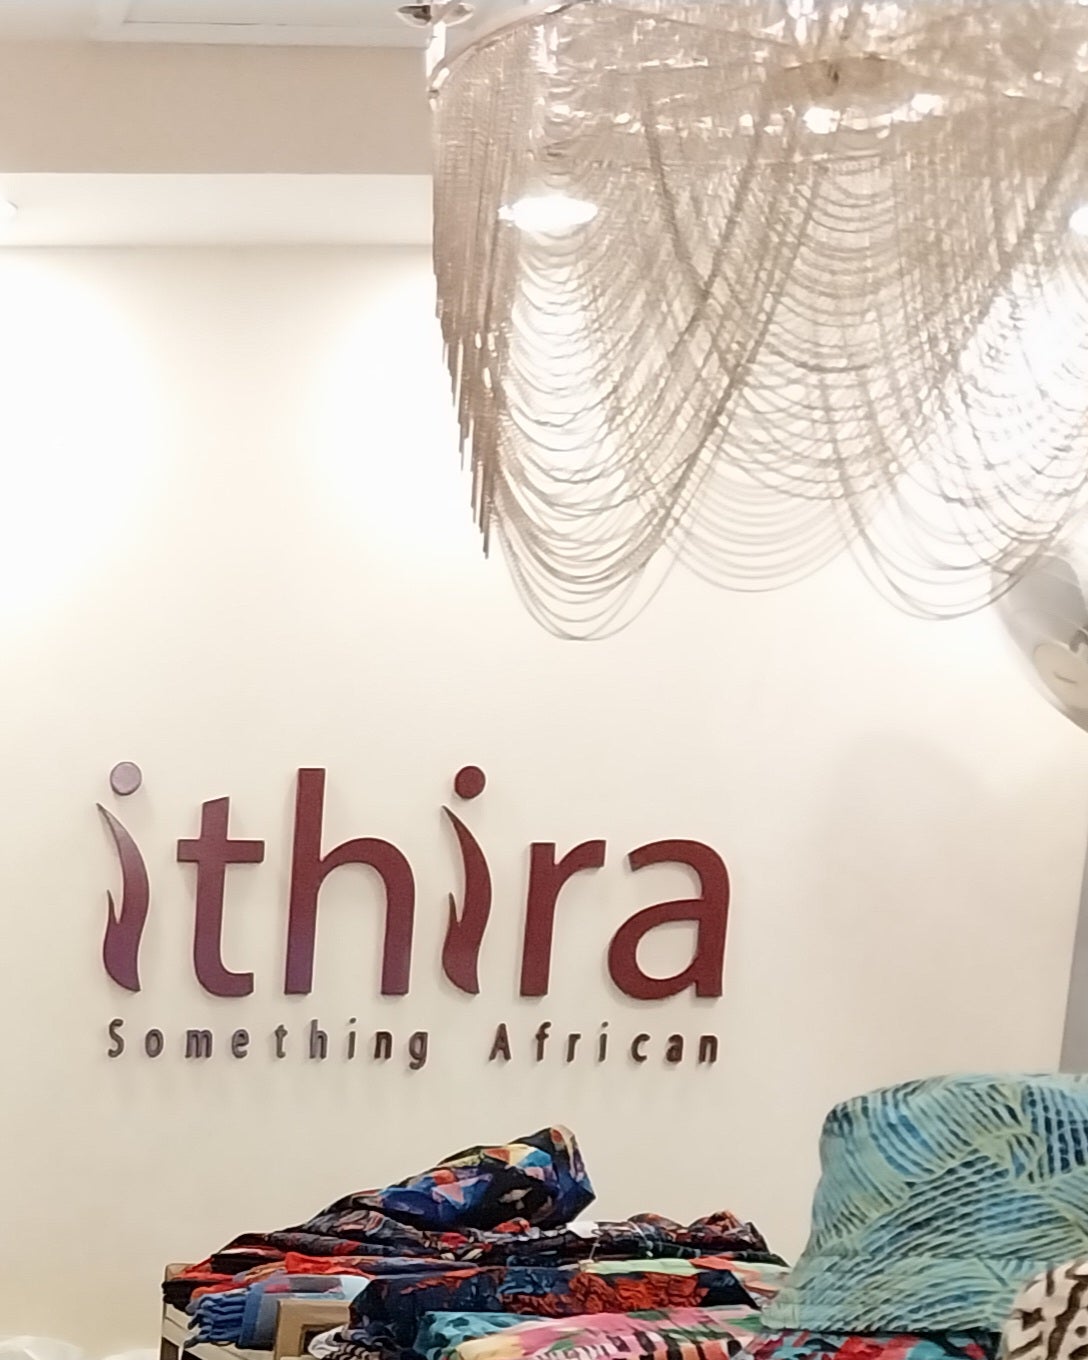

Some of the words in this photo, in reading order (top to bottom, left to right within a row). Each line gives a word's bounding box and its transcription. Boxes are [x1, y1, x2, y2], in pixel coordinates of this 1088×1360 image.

[96, 761, 731, 1000] ithira
[107, 1017, 429, 1070] Something
[489, 1020, 719, 1064] African
